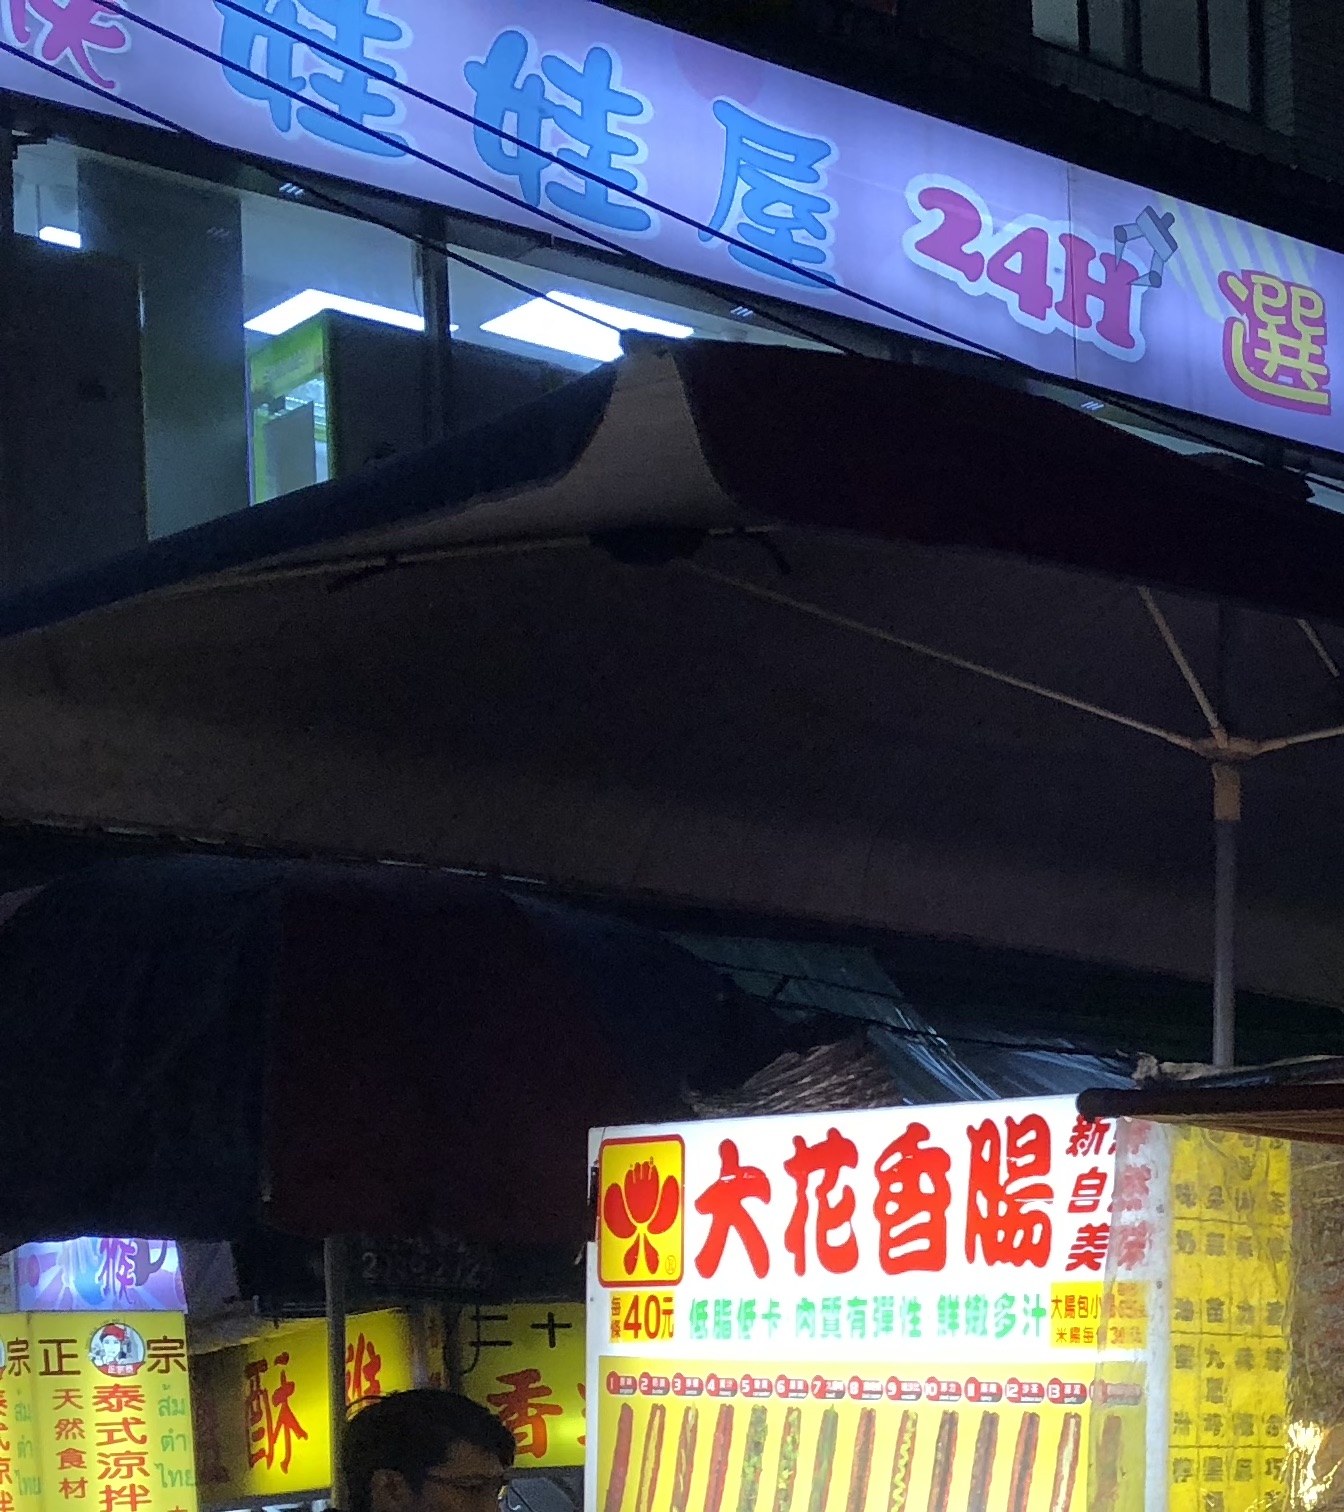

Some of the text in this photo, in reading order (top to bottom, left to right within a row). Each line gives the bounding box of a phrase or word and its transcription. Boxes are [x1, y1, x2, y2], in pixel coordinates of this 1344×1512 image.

[906, 176, 1143, 356] 24H
[694, 1113, 1055, 1281] 大花香腸
[624, 1293, 674, 1339] 40元
[689, 1297, 781, 1340] 低脂低卡
[7, 1335, 187, 1376] 宗 正 宗
[53, 1388, 88, 1499] 天然食材
